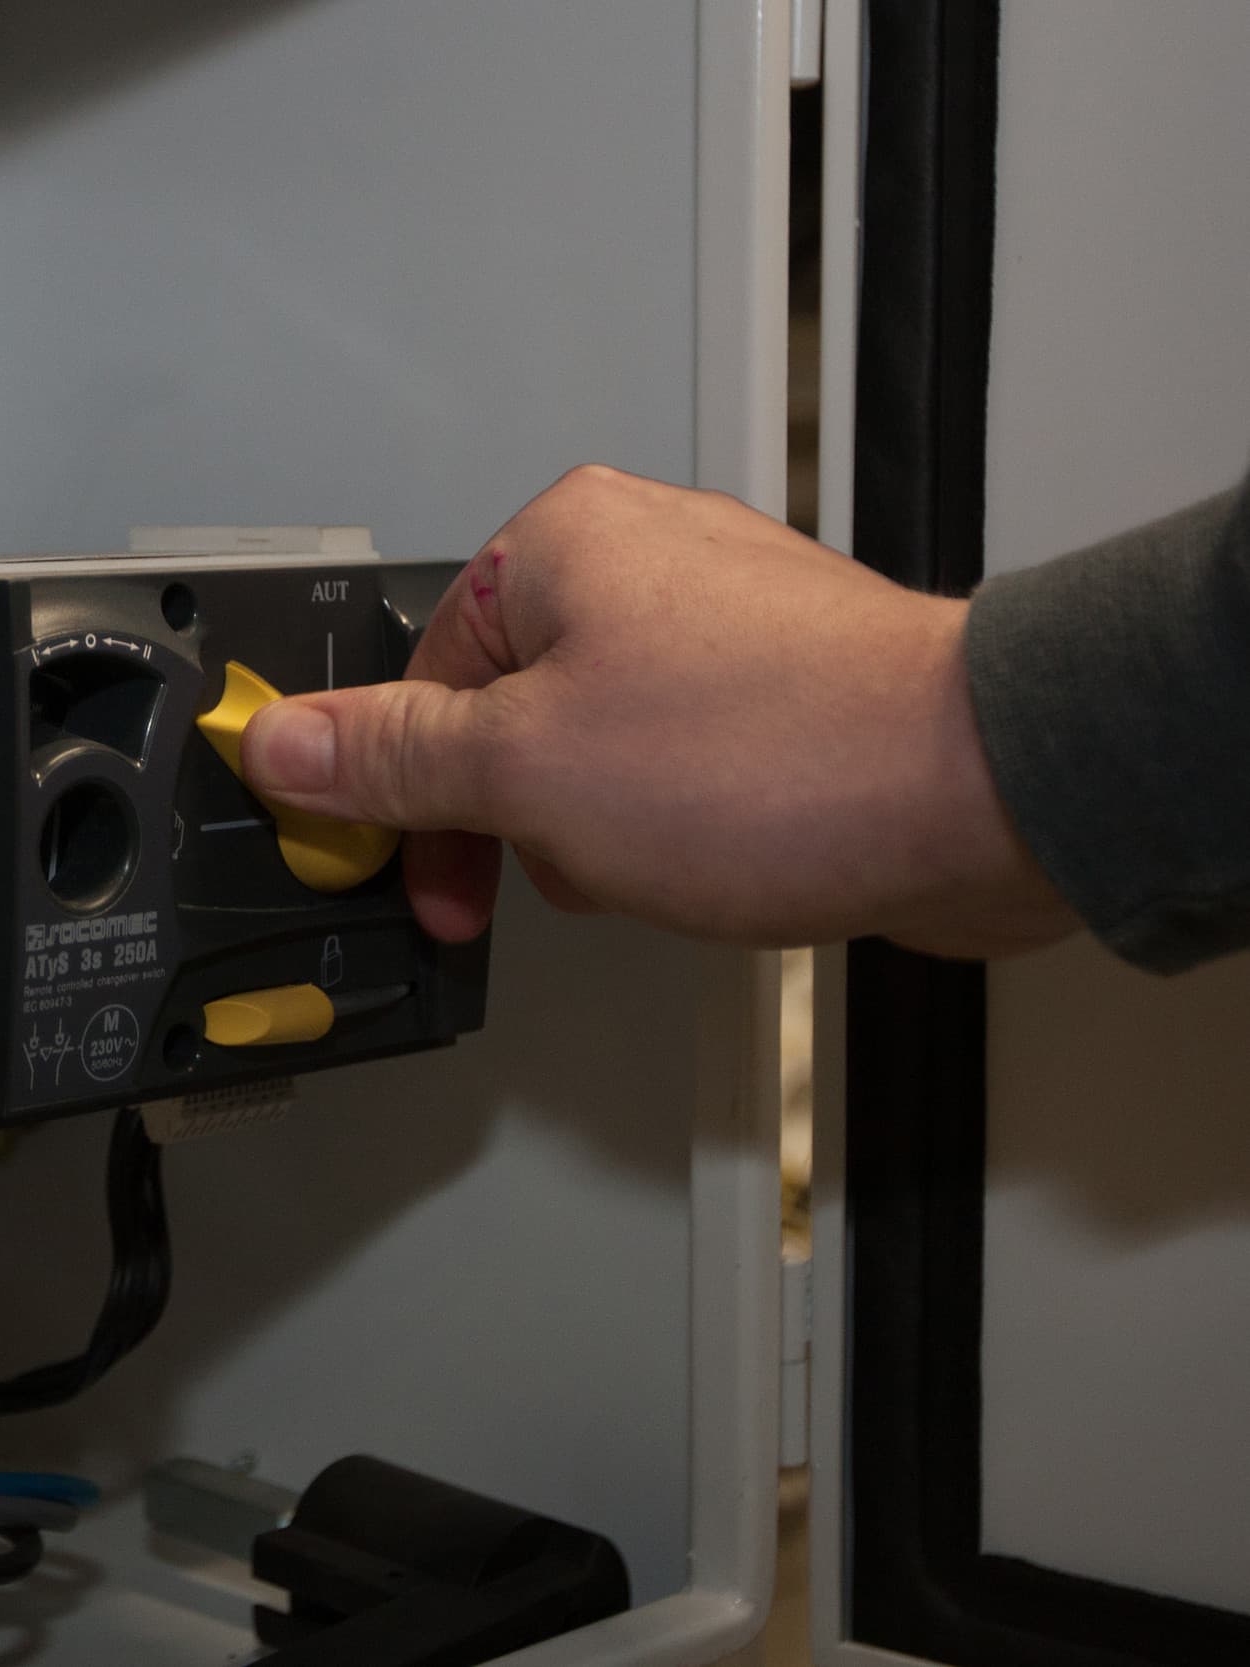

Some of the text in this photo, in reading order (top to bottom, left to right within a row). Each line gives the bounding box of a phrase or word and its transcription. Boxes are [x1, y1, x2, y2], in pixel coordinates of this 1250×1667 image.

[311, 580, 350, 602] AUT
[24, 939, 157, 981] ATyS 3s 250A
[103, 1010, 120, 1033] M
